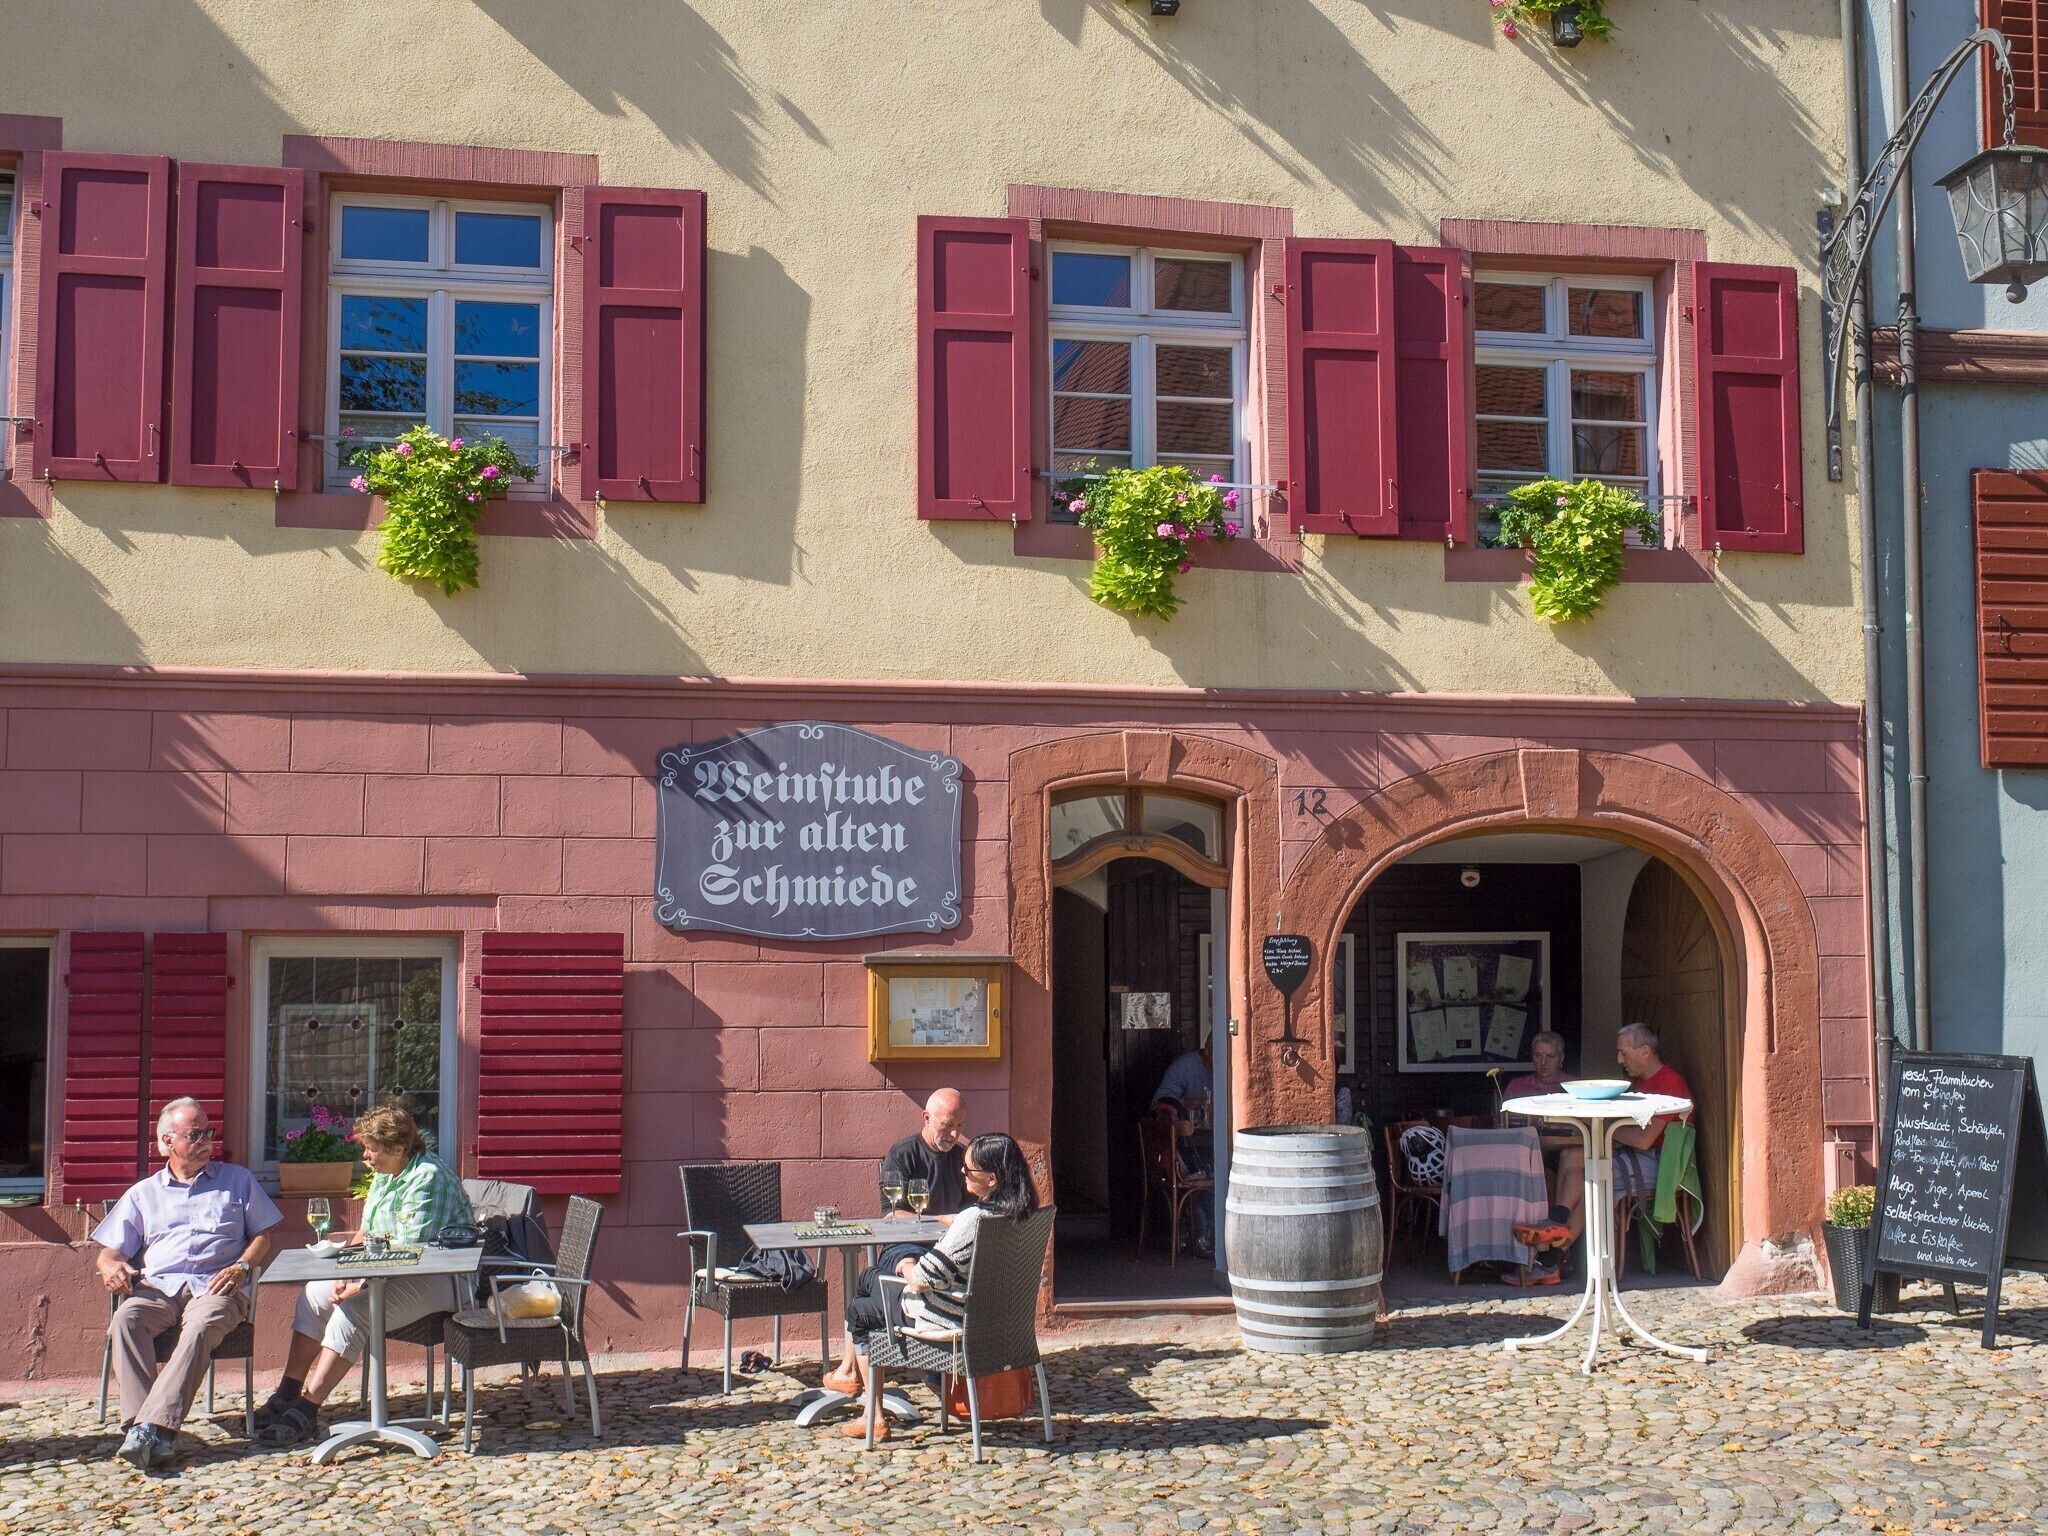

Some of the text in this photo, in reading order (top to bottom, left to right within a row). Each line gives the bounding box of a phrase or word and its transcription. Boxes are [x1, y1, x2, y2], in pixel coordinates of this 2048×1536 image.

[1293, 788, 1328, 816] 12
[711, 811, 909, 862] zur alten
[699, 863, 919, 918] Schmiede
[1929, 1069, 1994, 1089] Flammkuchen
[1901, 1083, 1965, 1105] vom Steinofen
[1897, 1114, 1954, 1135] Wurstsalat,
[1894, 1129, 1958, 1152] Rindfleissalat,
[1890, 1174, 1917, 1200] Hugo,
[1883, 1222, 1907, 1246] Kaffee
[1909, 1233, 1919, 1244] &
[1962, 1213, 1993, 1234] Kuchen
[1916, 1251, 1978, 1268] und vieles mehr
